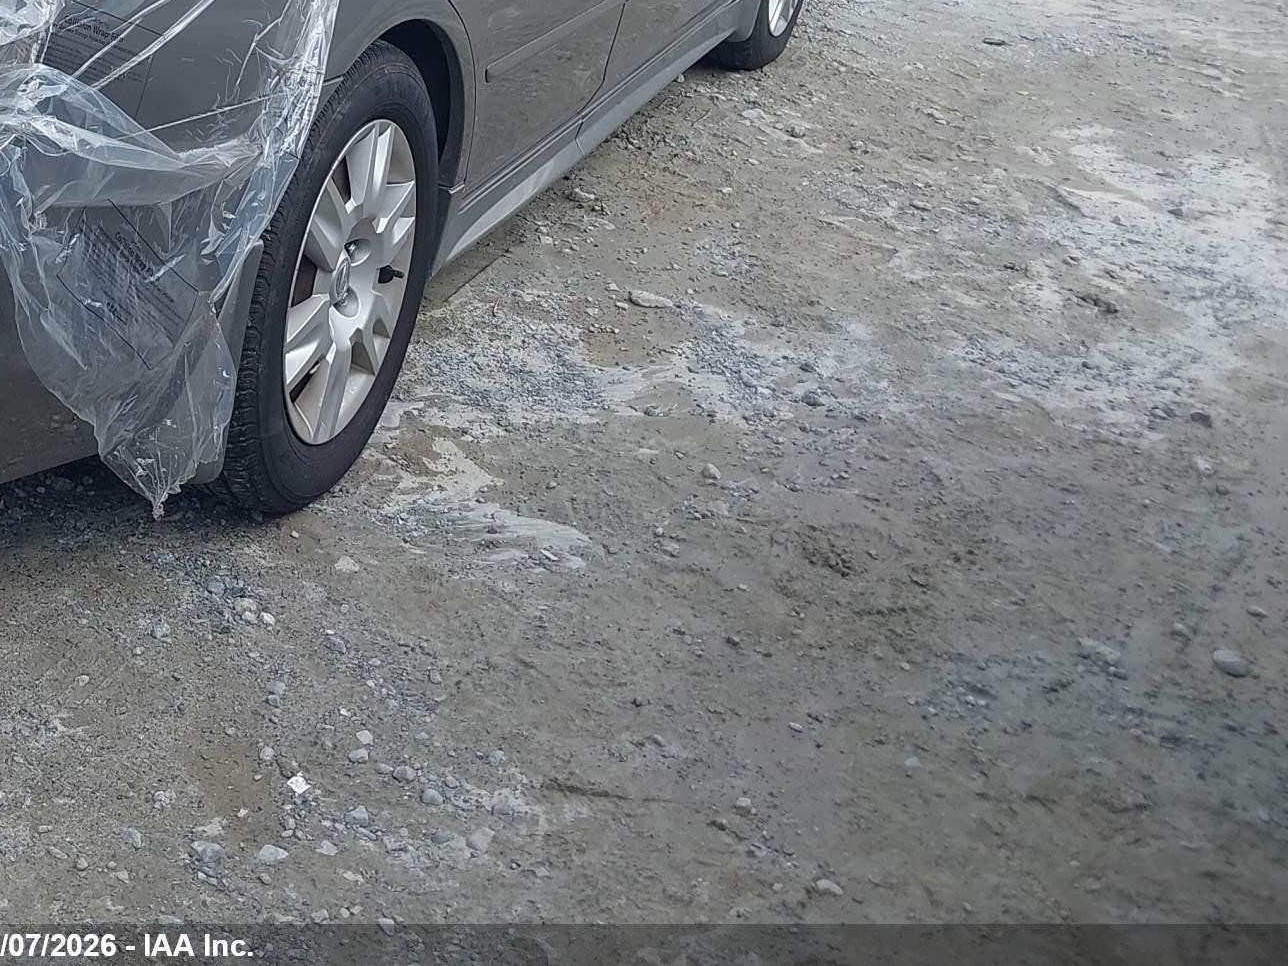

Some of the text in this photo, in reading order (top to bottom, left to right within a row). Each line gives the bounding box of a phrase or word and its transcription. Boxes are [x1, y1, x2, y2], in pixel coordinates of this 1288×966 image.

[64, 17, 124, 44] Collion Wrap Fim
